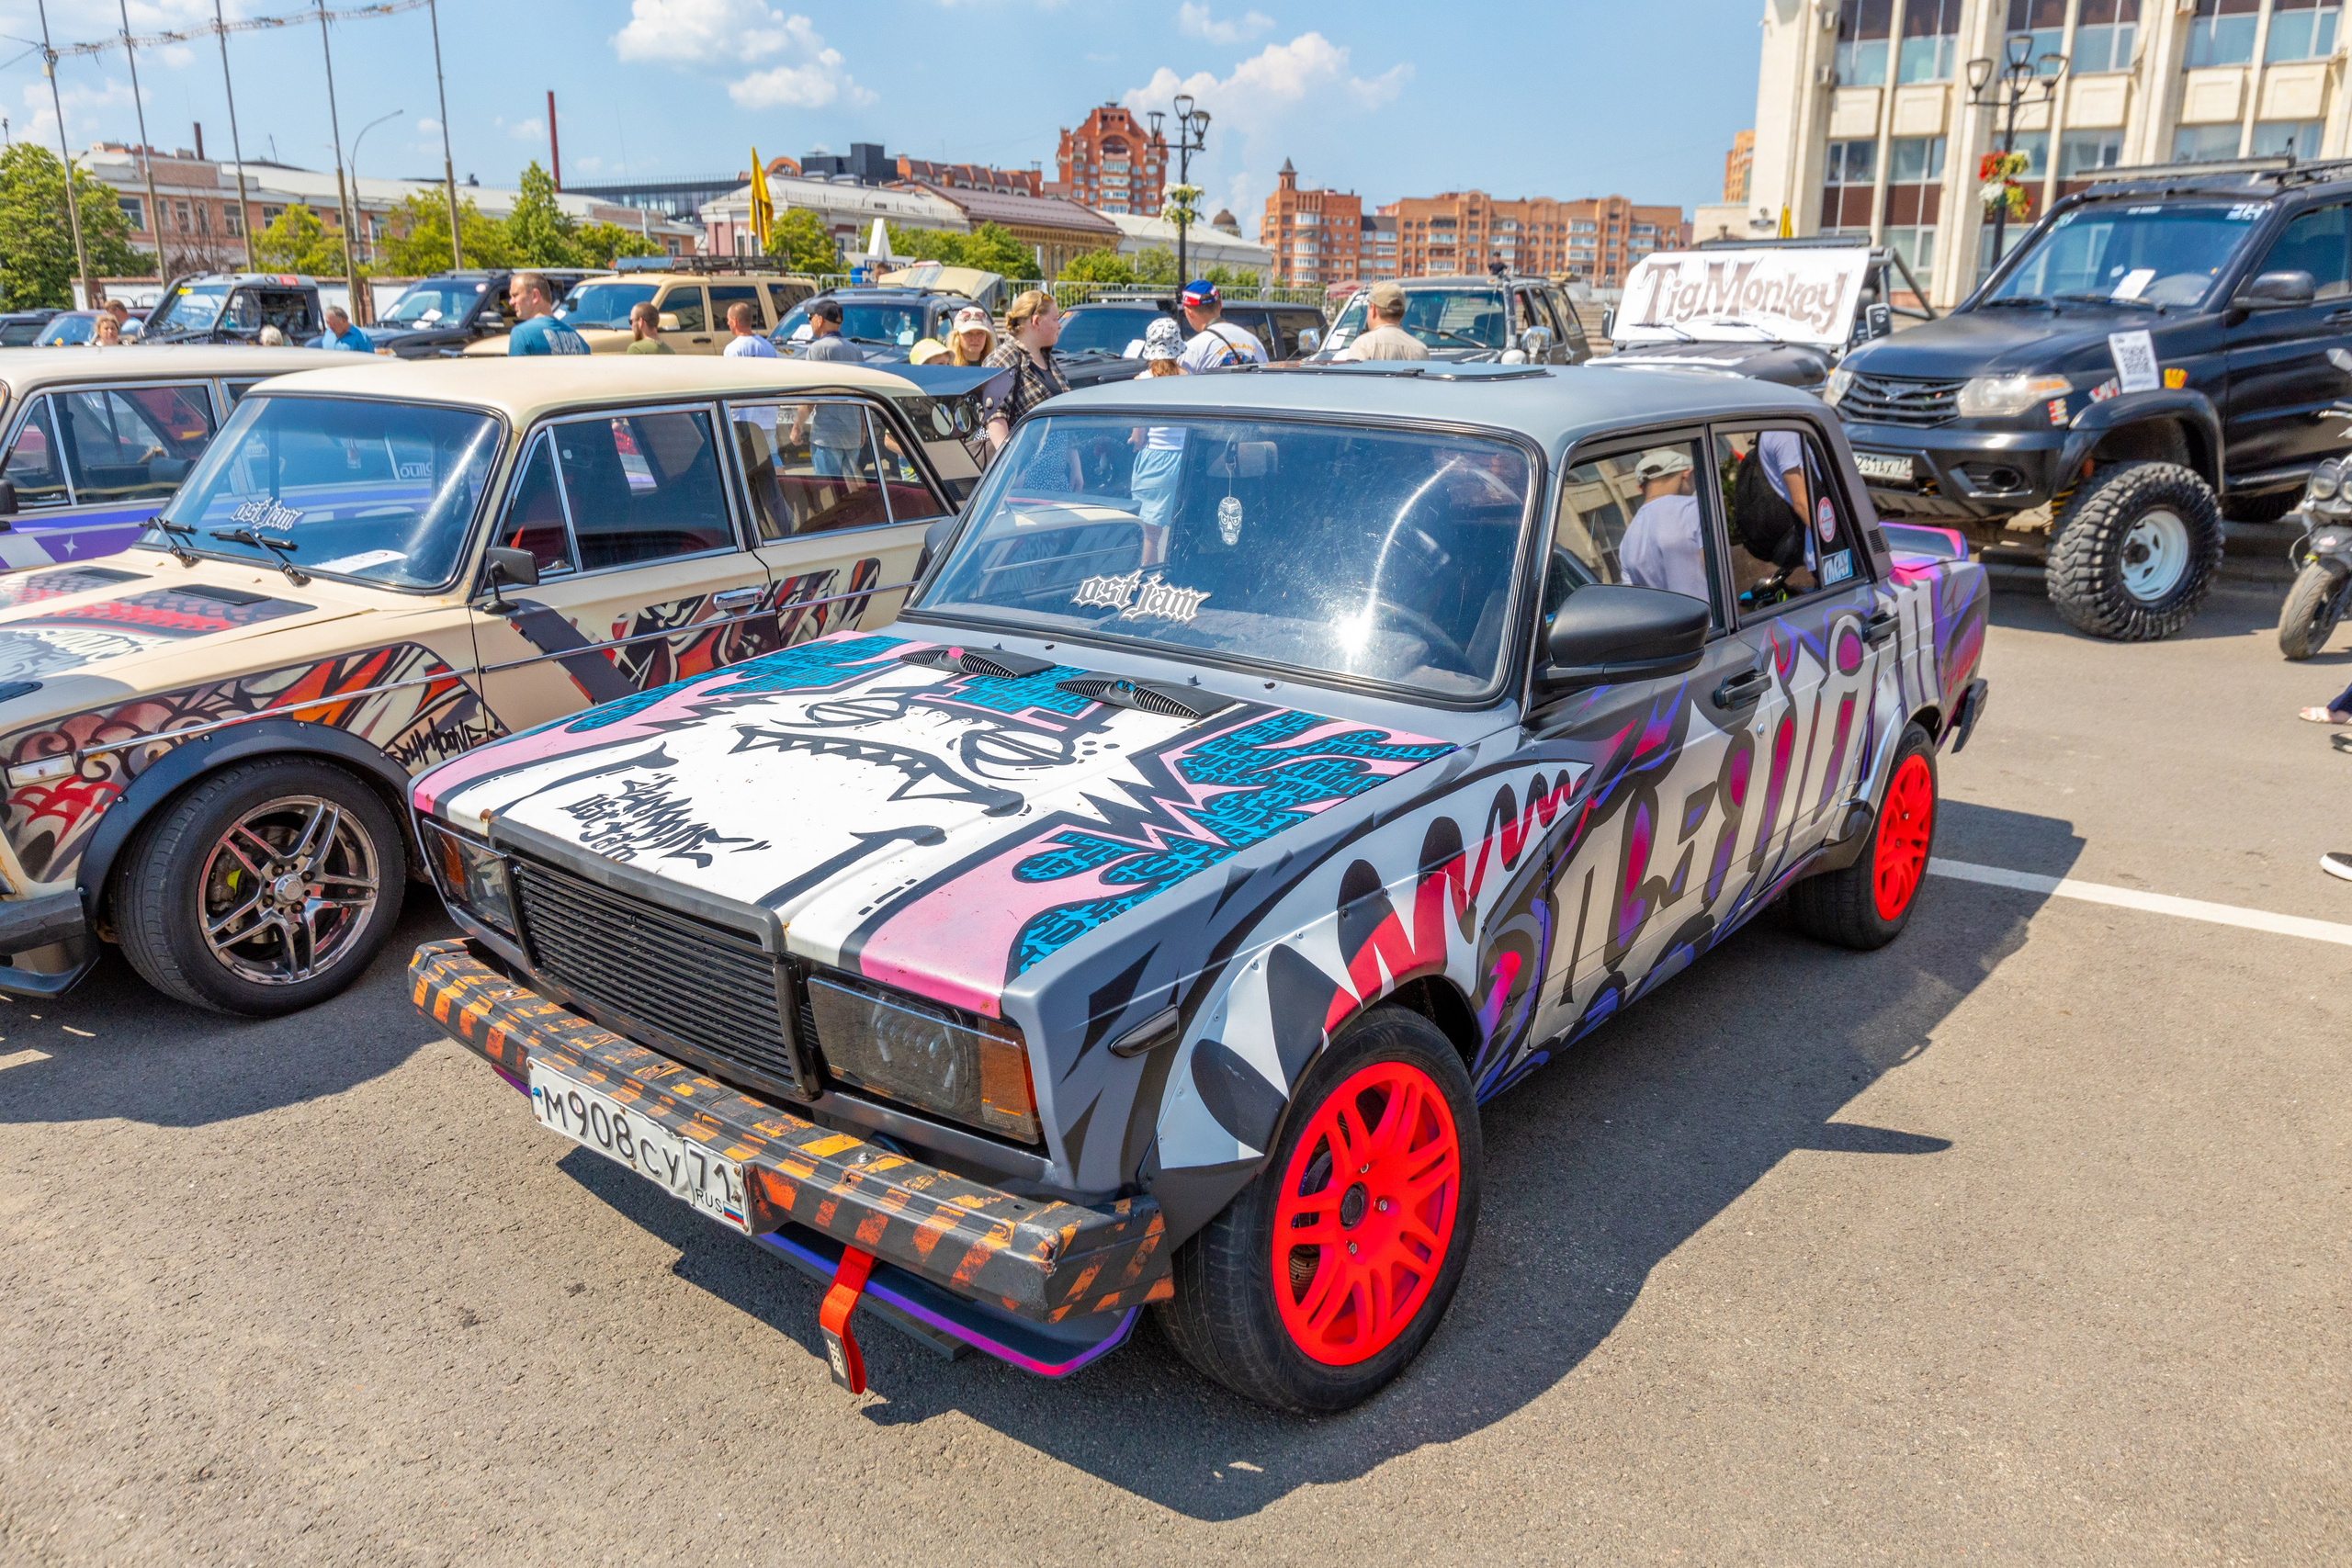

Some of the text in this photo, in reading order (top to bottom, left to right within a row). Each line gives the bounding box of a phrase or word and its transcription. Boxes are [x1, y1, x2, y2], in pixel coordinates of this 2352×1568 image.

[1636, 256, 1855, 335] TigMonkey
[1070, 568, 1212, 625] ost jam
[695, 1187, 723, 1214] RUS
